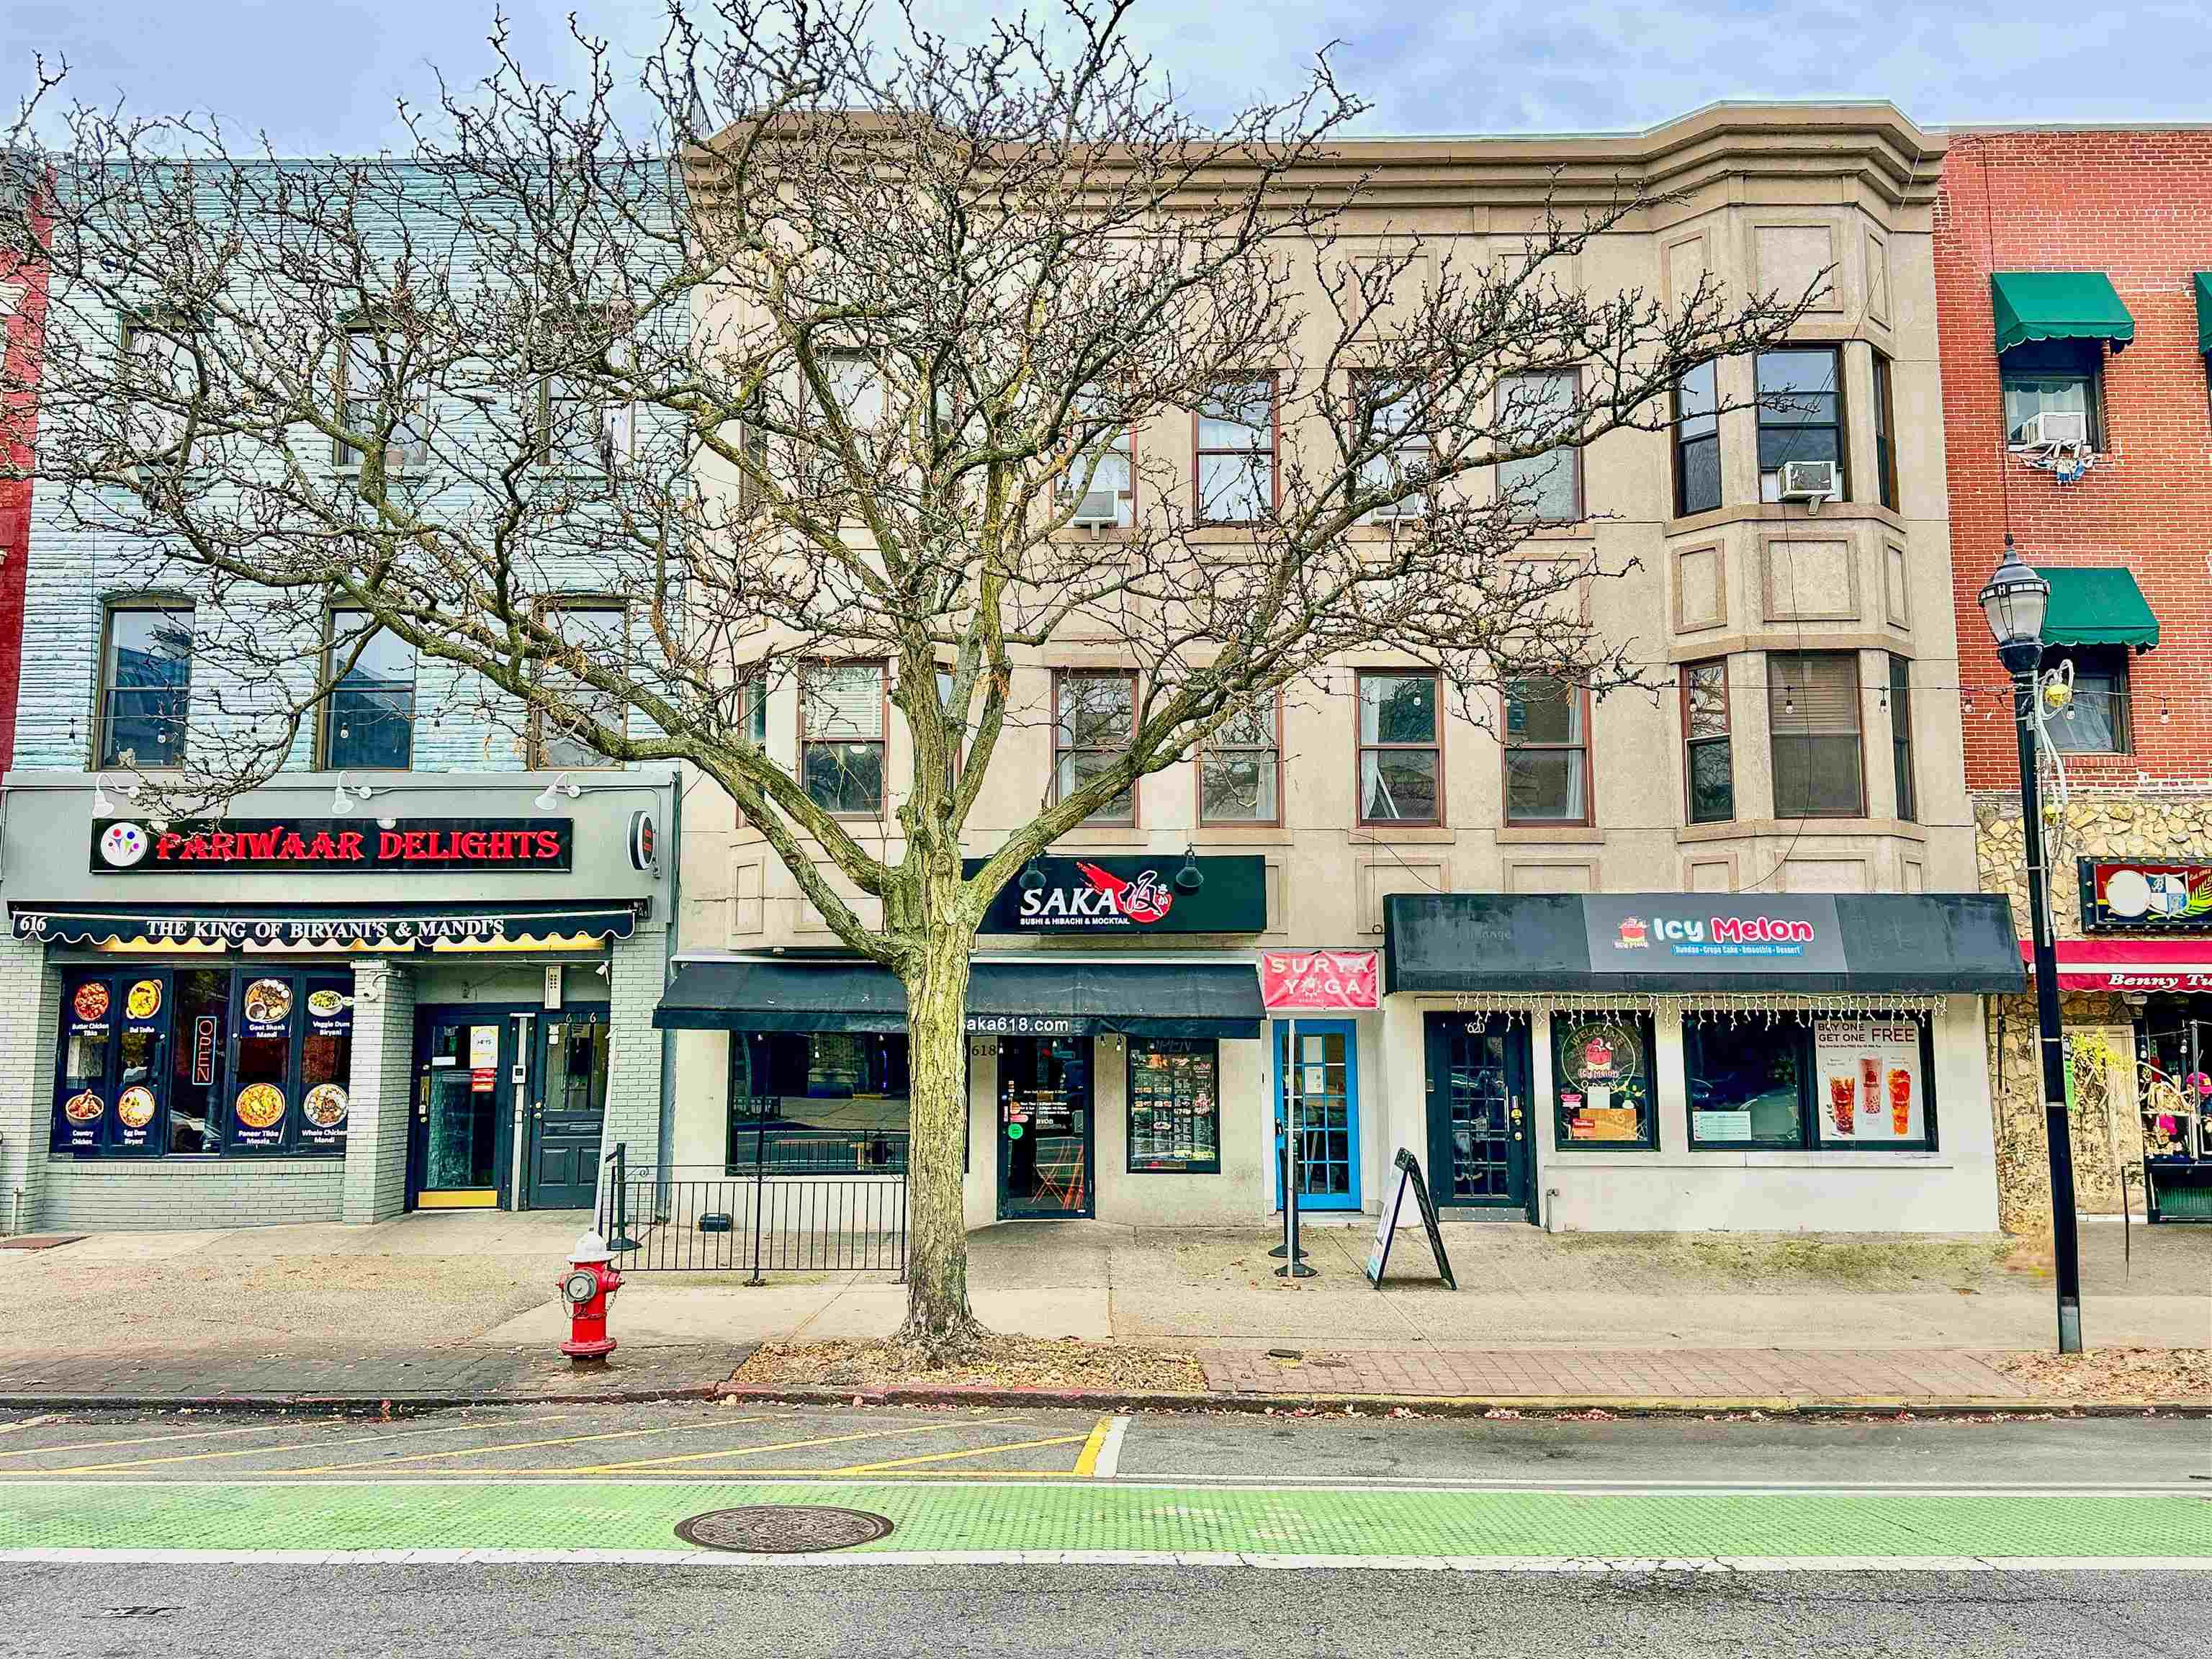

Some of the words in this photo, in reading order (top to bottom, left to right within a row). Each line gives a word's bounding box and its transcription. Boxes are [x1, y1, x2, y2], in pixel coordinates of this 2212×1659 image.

[156, 825, 365, 862] PARIWAAR
[377, 830, 561, 860] DELIGHTS
[1020, 887, 1120, 916] SAKA
[19, 915, 48, 932] 616
[146, 920, 187, 937] THE
[194, 921, 247, 938] KING
[254, 922, 283, 938] OF
[290, 921, 388, 938] BIRYANI'S
[394, 922, 413, 937] &
[418, 919, 505, 937] MANDI'S
[1653, 917, 1704, 943] Icy
[1710, 917, 1815, 944] Melon
[1271, 957, 1370, 974] SURYA
[2108, 974, 2179, 989] Benny
[966, 1016, 1069, 1032] aka618.com
[1467, 1022, 1485, 1034] 620
[1818, 1022, 1839, 1032] BUY
[1842, 1022, 1866, 1032] ONE
[1571, 1026, 1625, 1048] WELCOME
[1819, 1033, 1841, 1042] GET
[1843, 1033, 1866, 1042] ONE
[1872, 1028, 1915, 1043] FREE
[197, 1020, 213, 1082] OPEN
[972, 1045, 997, 1056] 618
